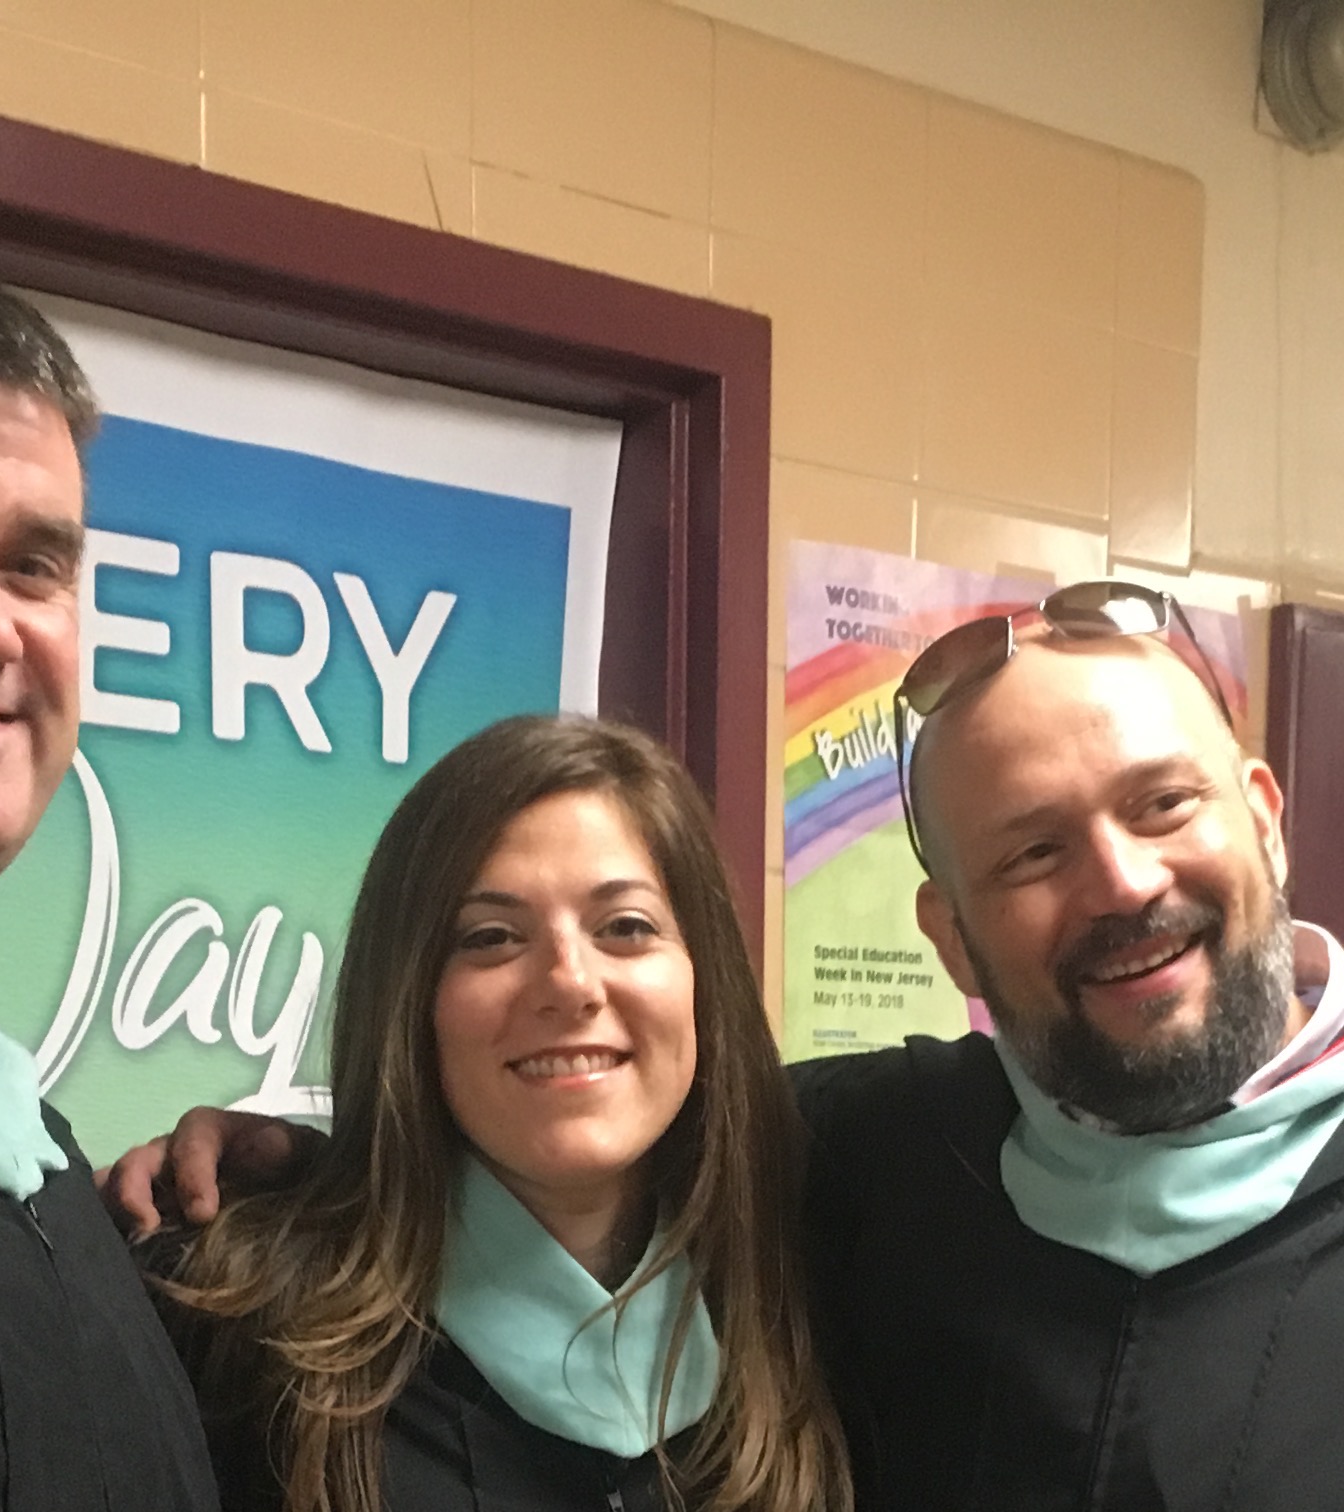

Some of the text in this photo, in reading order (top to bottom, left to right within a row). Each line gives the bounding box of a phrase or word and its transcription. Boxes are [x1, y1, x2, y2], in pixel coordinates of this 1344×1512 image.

[825, 585, 909, 616] WORKIN
[78, 528, 457, 764] ERY
[814, 701, 897, 780] Build
[814, 945, 923, 964] Special Education
[814, 967, 847, 981] Week
[866, 970, 893, 983] New
[897, 972, 934, 988] Jersey
[814, 991, 837, 1007] May
